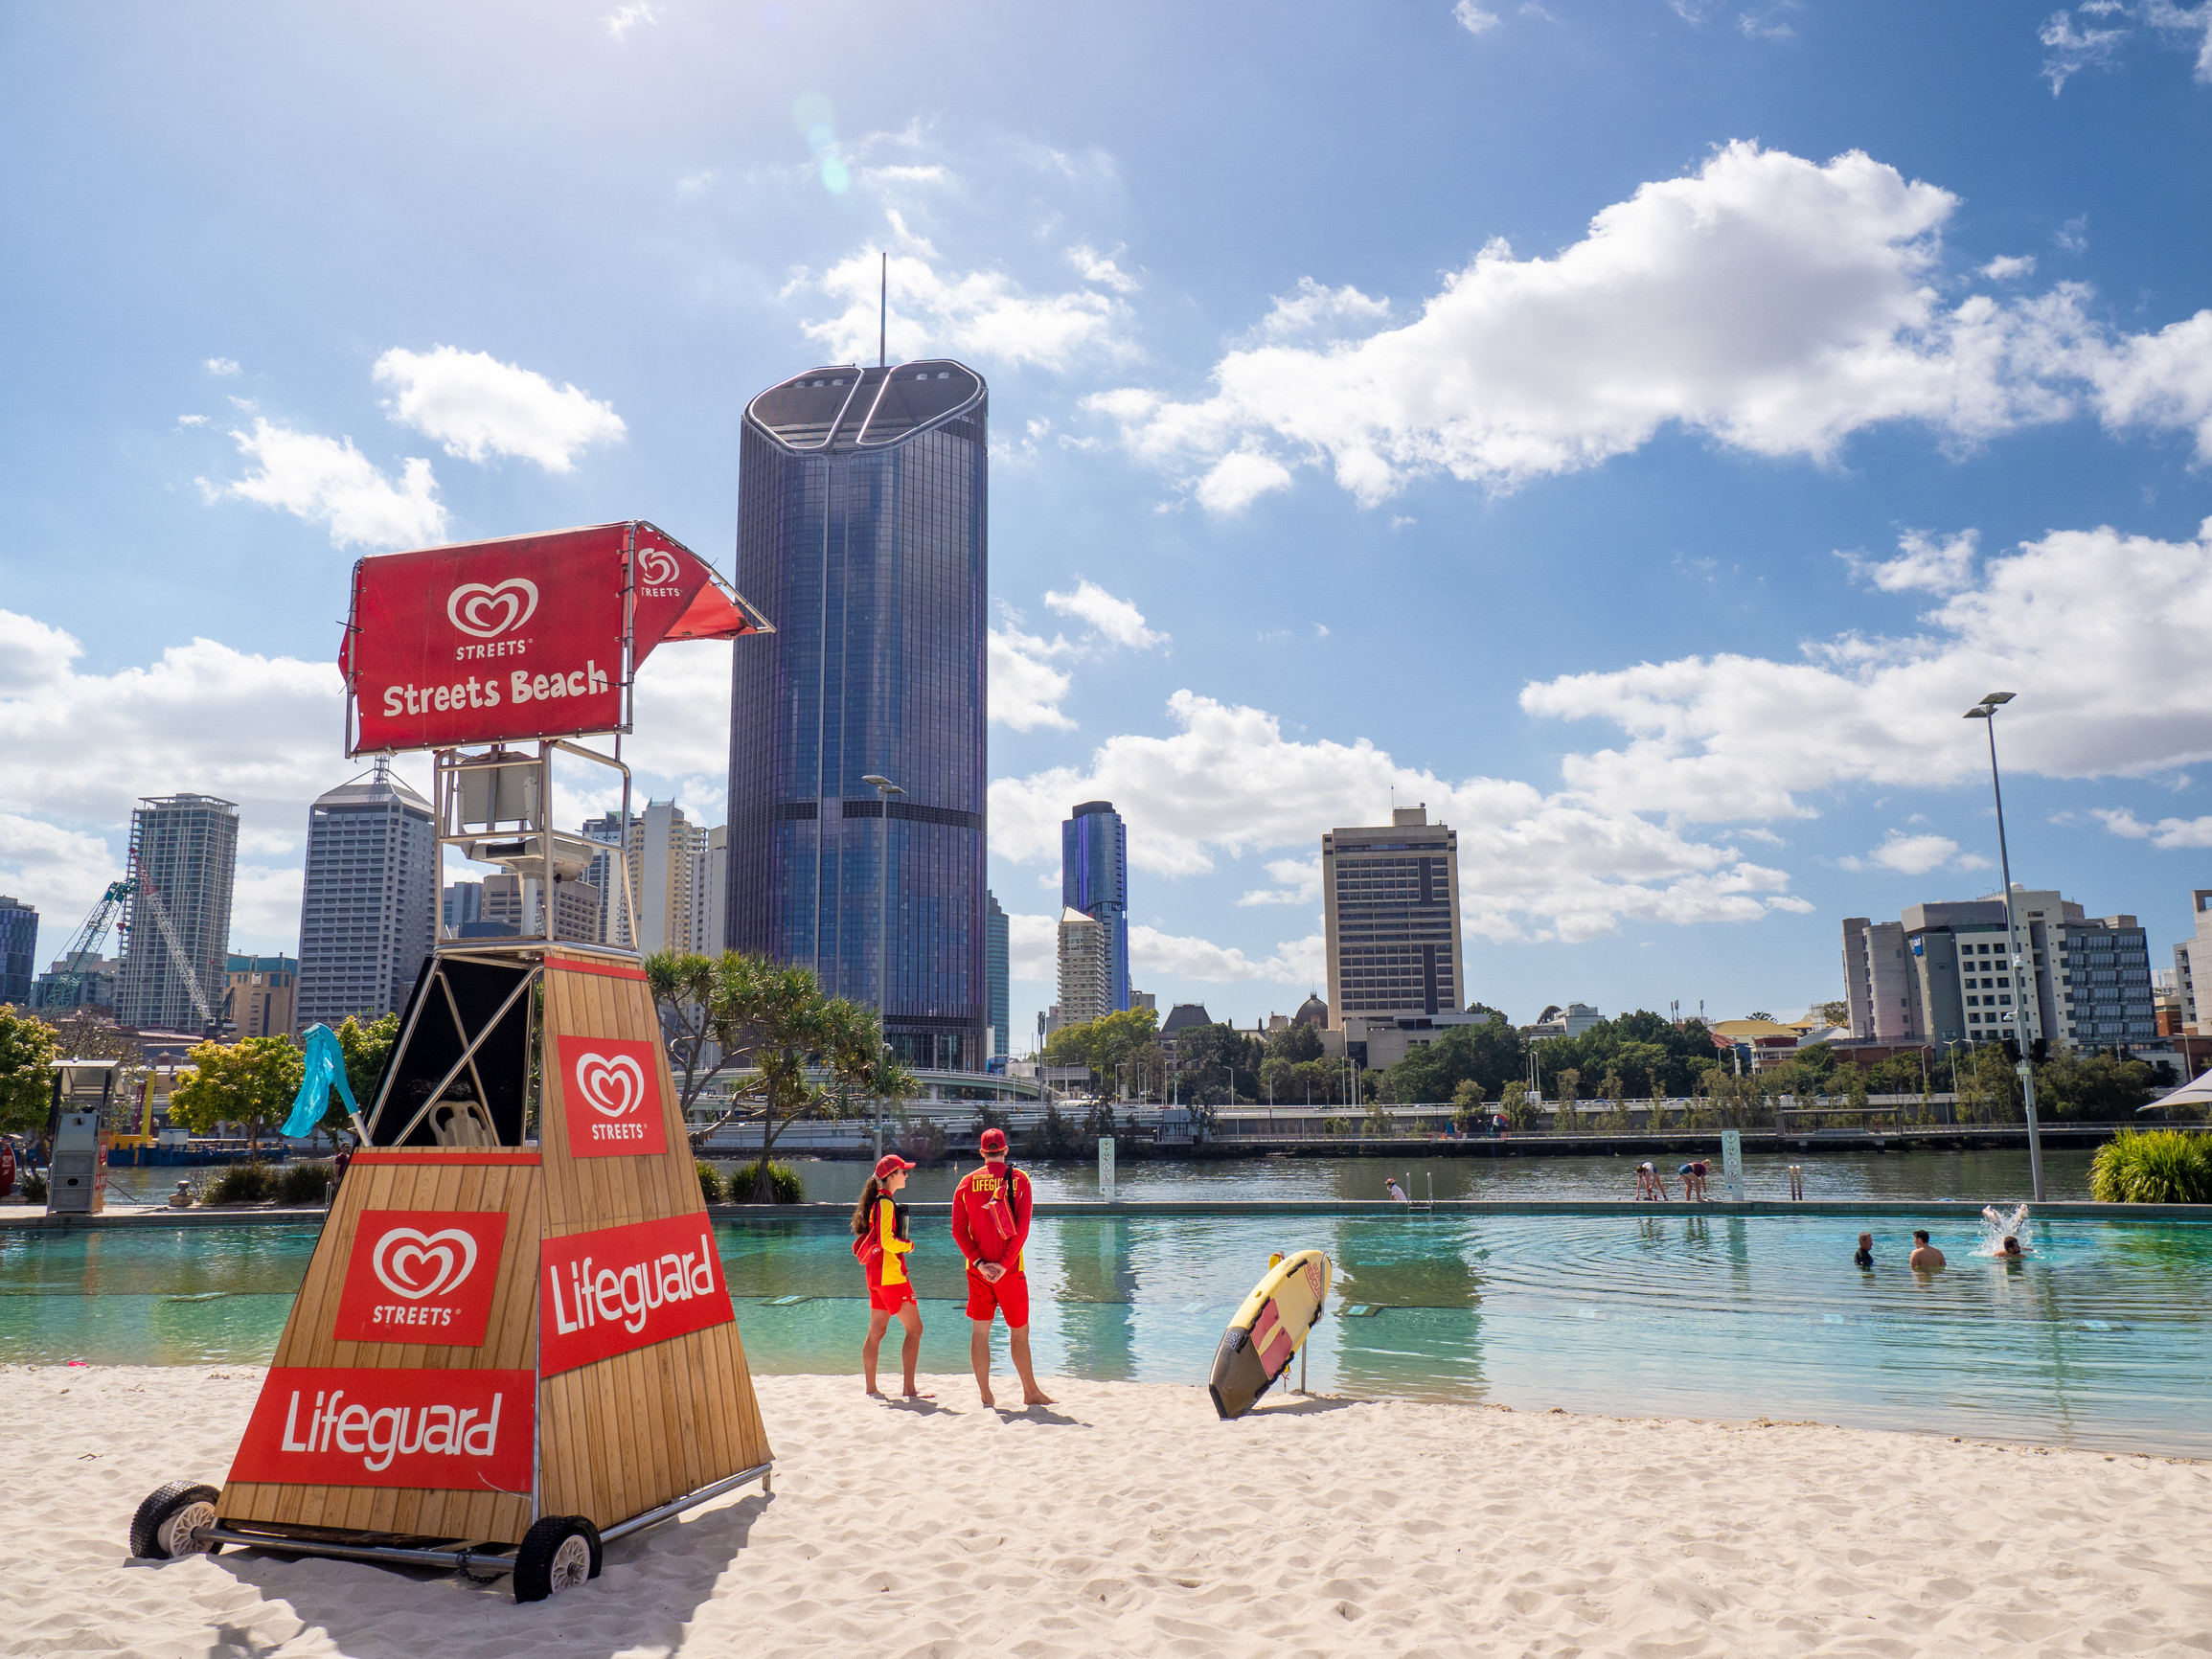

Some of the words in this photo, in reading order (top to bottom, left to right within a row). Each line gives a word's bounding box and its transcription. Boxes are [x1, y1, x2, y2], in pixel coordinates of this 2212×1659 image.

[641, 587, 680, 597] TREETS
[456, 639, 526, 661] STREETS
[383, 676, 501, 717] Streets
[511, 660, 608, 704] Beach
[591, 1123, 644, 1141] STREETS
[971, 1178, 1018, 1193] LIFEGUD
[550, 1234, 715, 1334] Lifeguard
[373, 1306, 452, 1326] STREETS
[281, 1390, 503, 1472] Lifeguard
